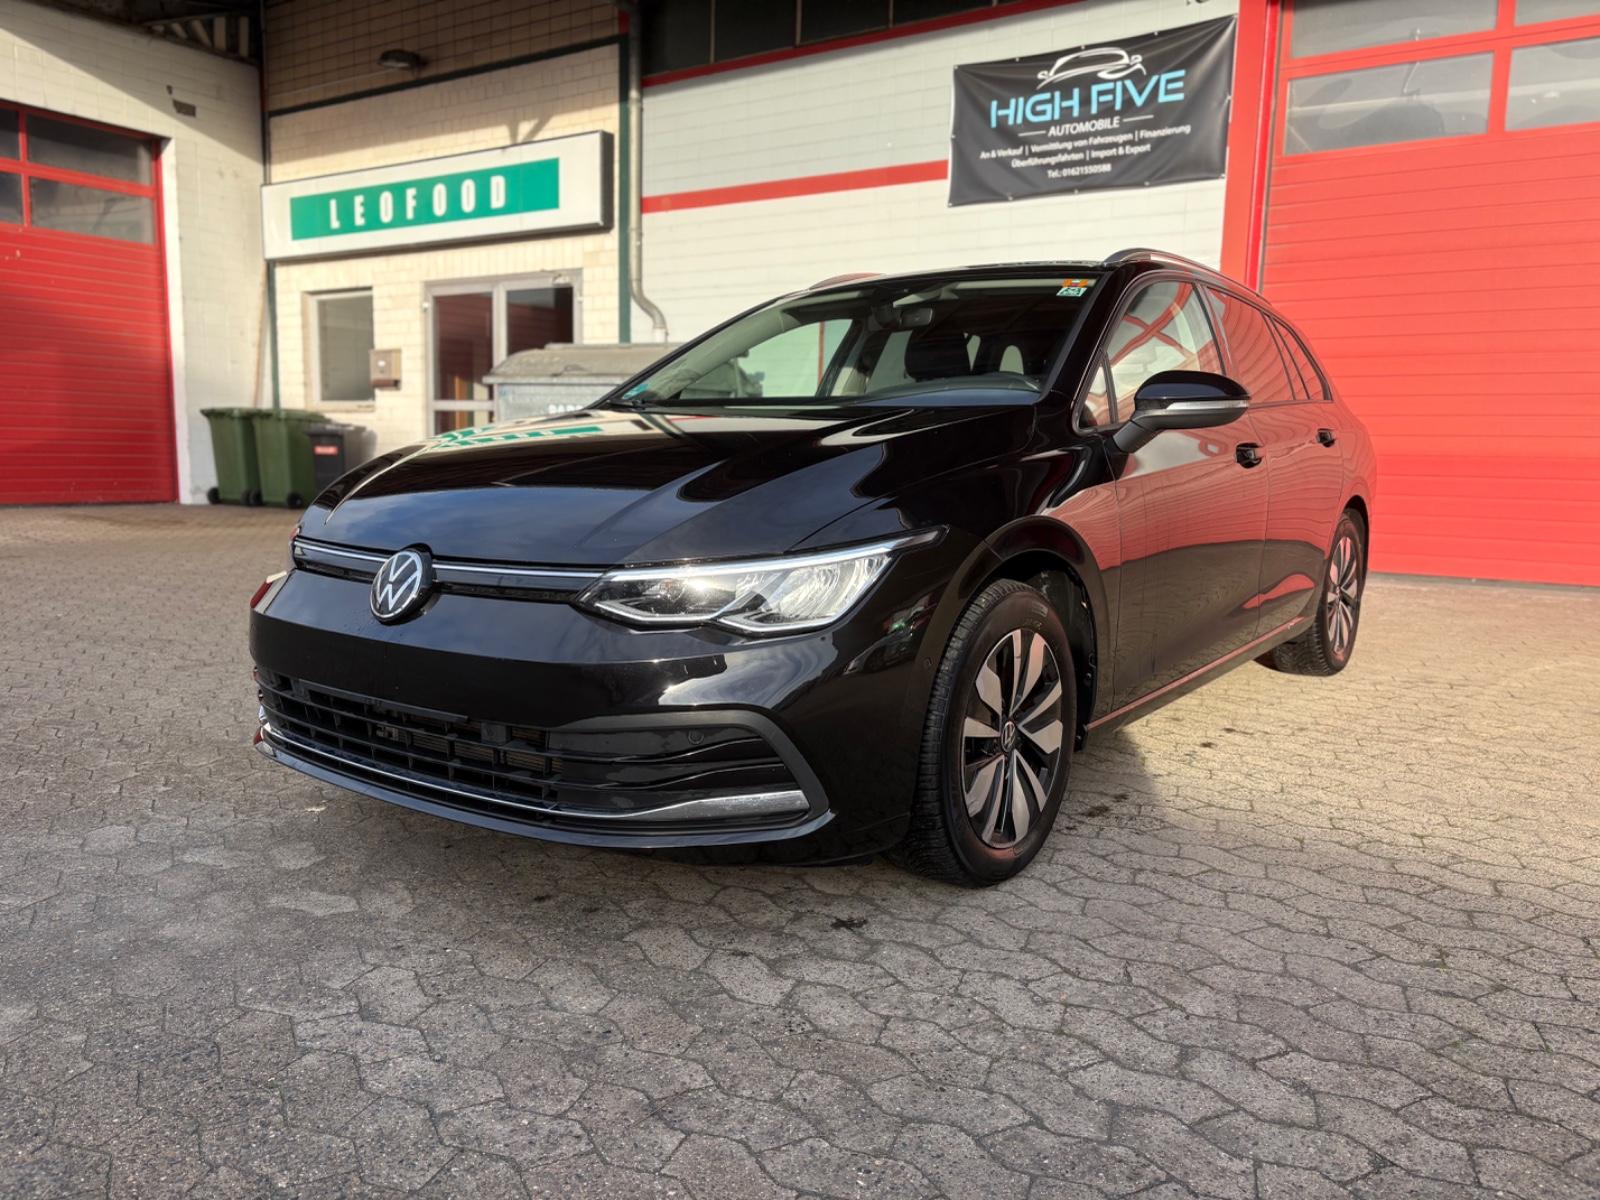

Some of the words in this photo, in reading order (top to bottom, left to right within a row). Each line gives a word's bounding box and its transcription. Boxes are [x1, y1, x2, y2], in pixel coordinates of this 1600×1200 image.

[990, 87, 1080, 128] HIGH
[1091, 69, 1186, 115] FIVE
[1047, 116, 1120, 137] AUTOMOBILE
[1140, 124, 1192, 139] Finanzierung
[1091, 147, 1117, 160] Import
[1118, 145, 1125, 156] &
[1125, 143, 1152, 155] Export
[329, 175, 506, 230] LEOFOOD
